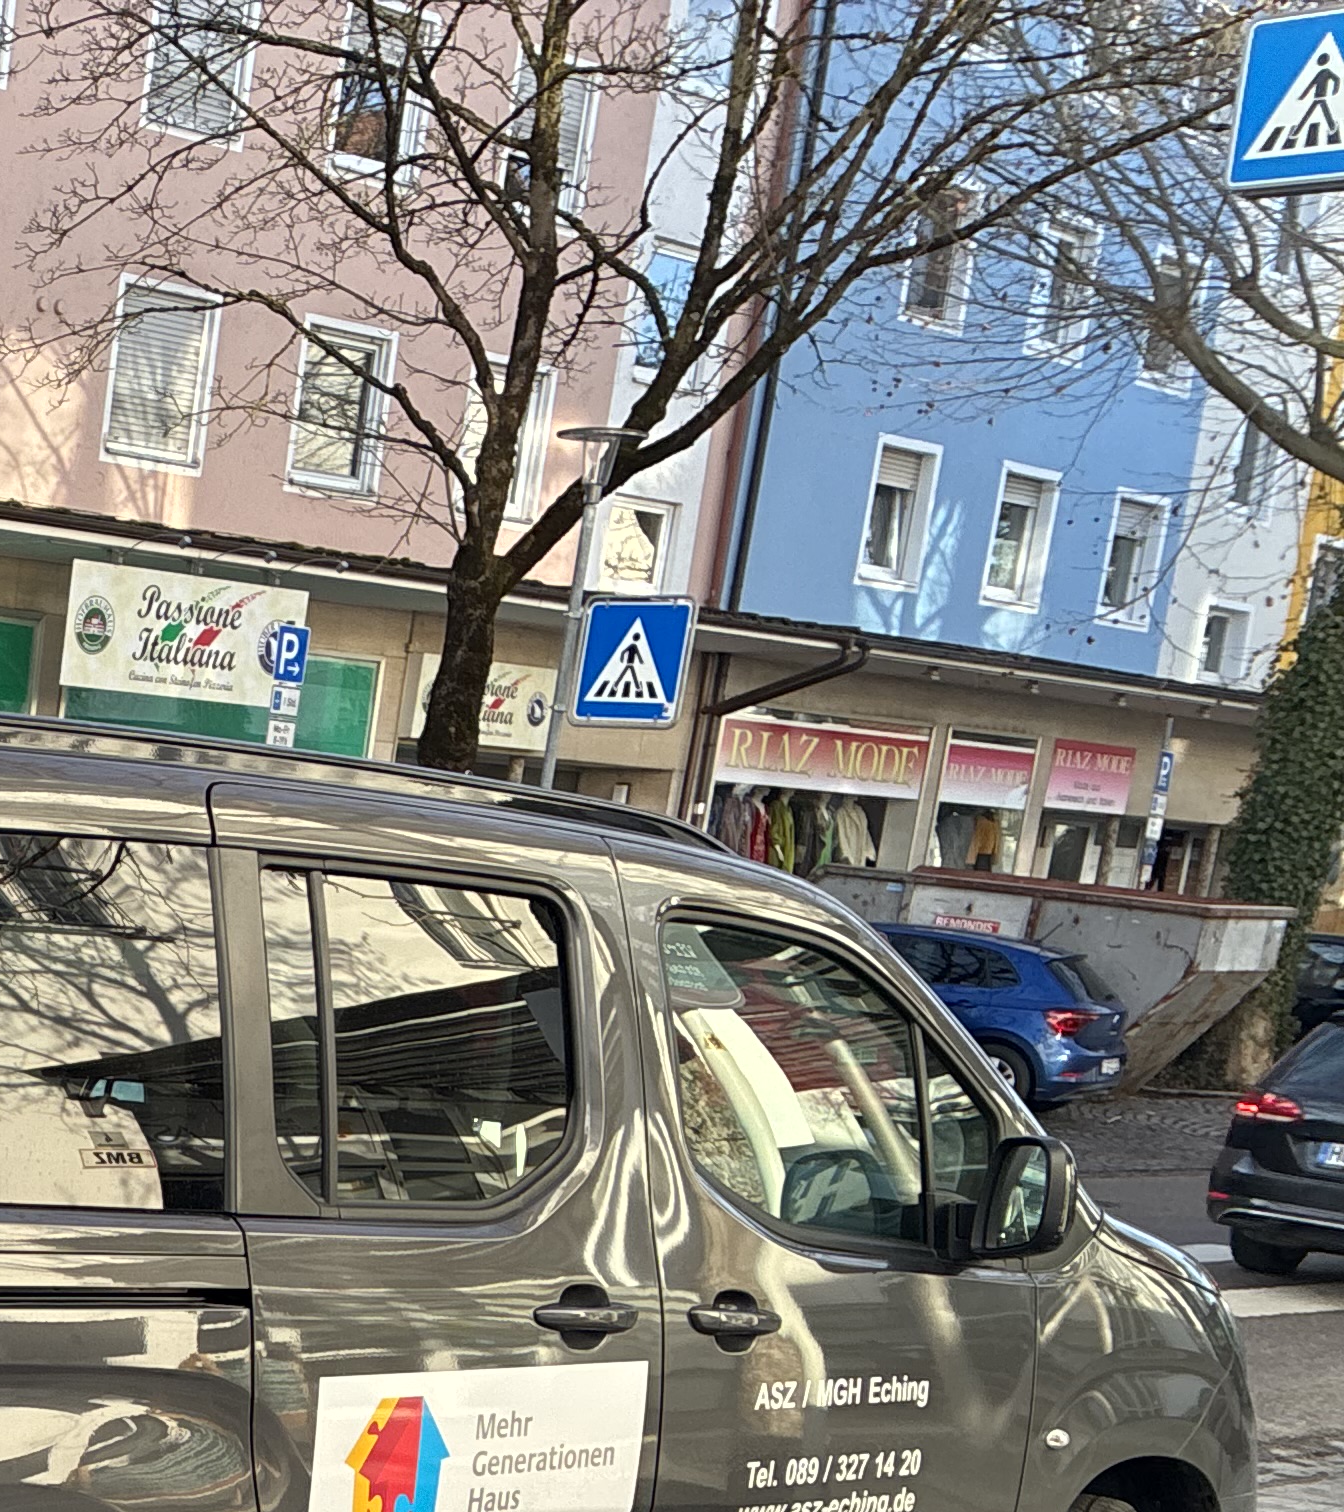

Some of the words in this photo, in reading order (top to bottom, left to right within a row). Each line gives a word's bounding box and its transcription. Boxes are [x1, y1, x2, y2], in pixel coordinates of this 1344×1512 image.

[137, 584, 242, 630] Passione
[132, 628, 236, 672] Italiana
[278, 632, 300, 675] P
[725, 728, 820, 777] RIAZ
[827, 739, 919, 788] MODE
[947, 763, 984, 782] RIAZ
[990, 768, 1028, 786] MODE
[1055, 748, 1092, 770] RIAZ
[1095, 753, 1133, 776] MODE
[935, 916, 994, 932] REMONDIS
[754, 1381, 797, 1410] ASZ
[802, 1380, 811, 1408] /
[816, 1378, 862, 1408] MGH
[868, 1375, 930, 1408] Eching
[475, 1410, 534, 1440] Mehr
[472, 1443, 616, 1477] Generationen
[746, 1460, 778, 1489] Tel.
[785, 1457, 820, 1487] 089
[822, 1455, 833, 1484] /
[835, 1453, 870, 1482] 327
[875, 1451, 896, 1478] 14
[898, 1449, 922, 1476] 20
